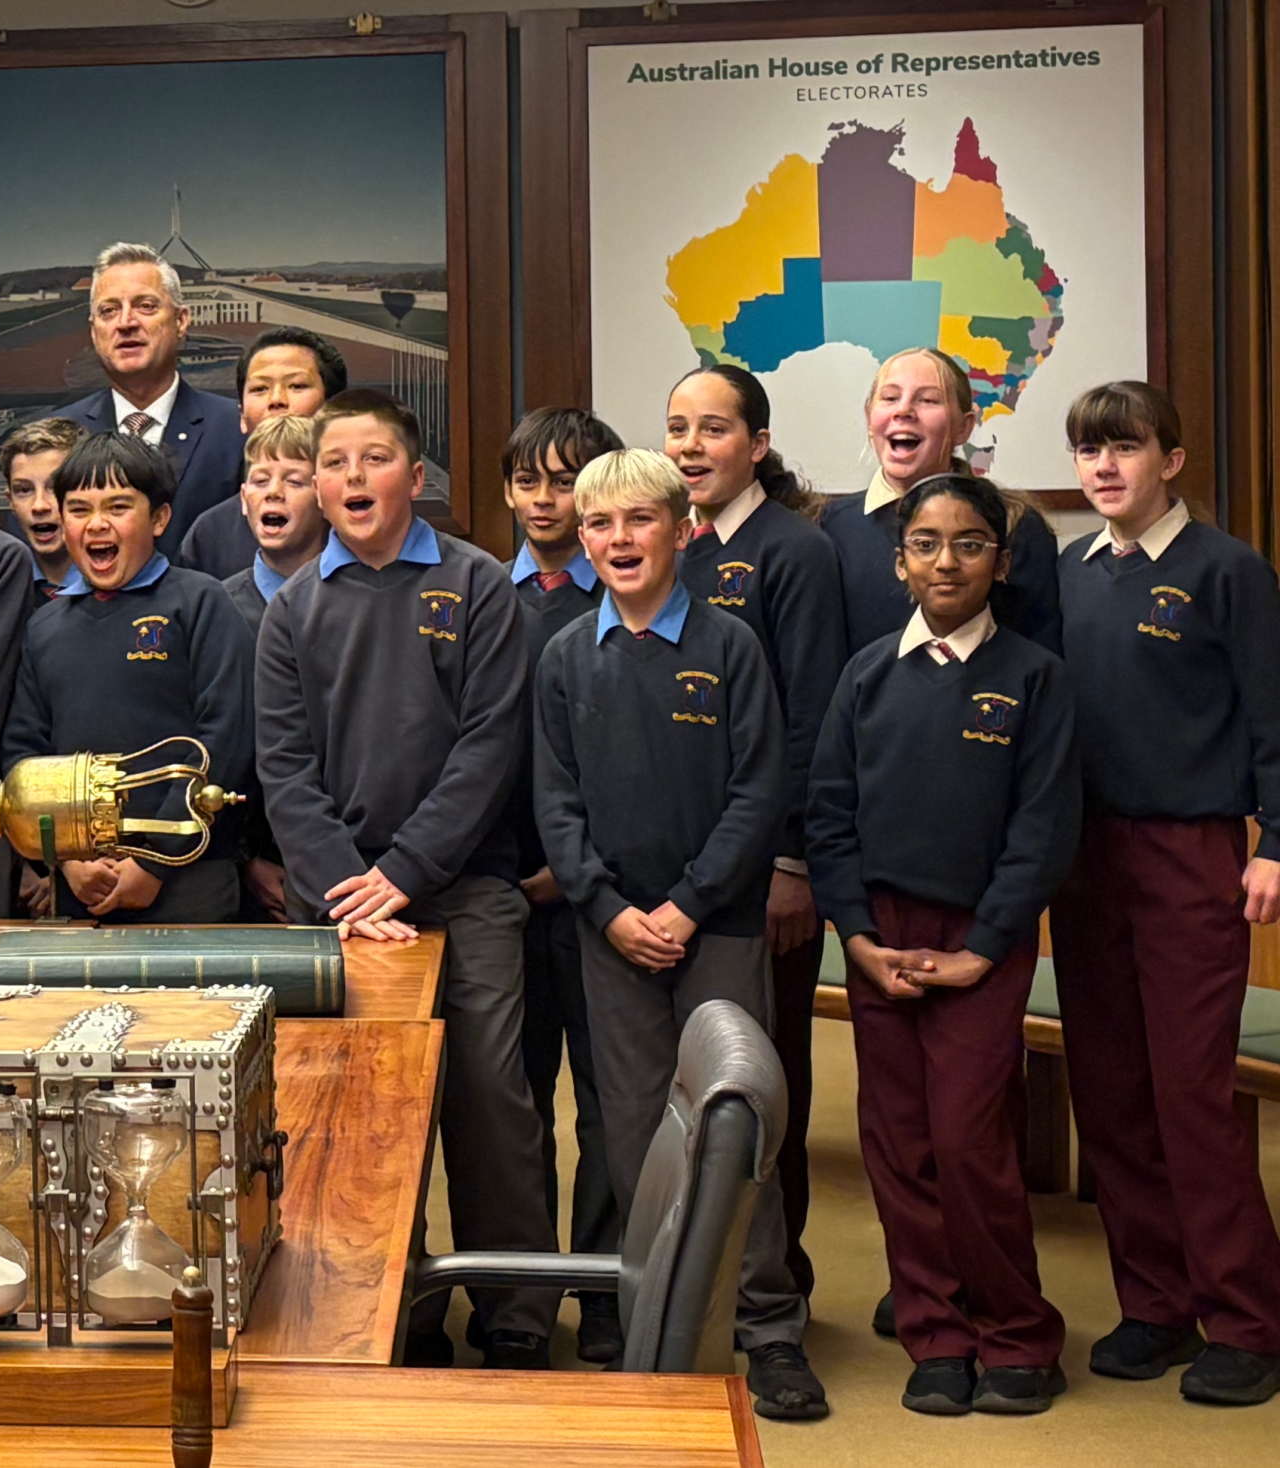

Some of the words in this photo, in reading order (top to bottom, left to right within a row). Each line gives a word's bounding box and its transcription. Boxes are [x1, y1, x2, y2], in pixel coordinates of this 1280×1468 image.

[627, 59, 760, 83] Australian
[769, 57, 848, 78] House
[856, 53, 884, 74] of
[891, 46, 1101, 77] Representatives
[796, 83, 928, 102] ELECTORATES
